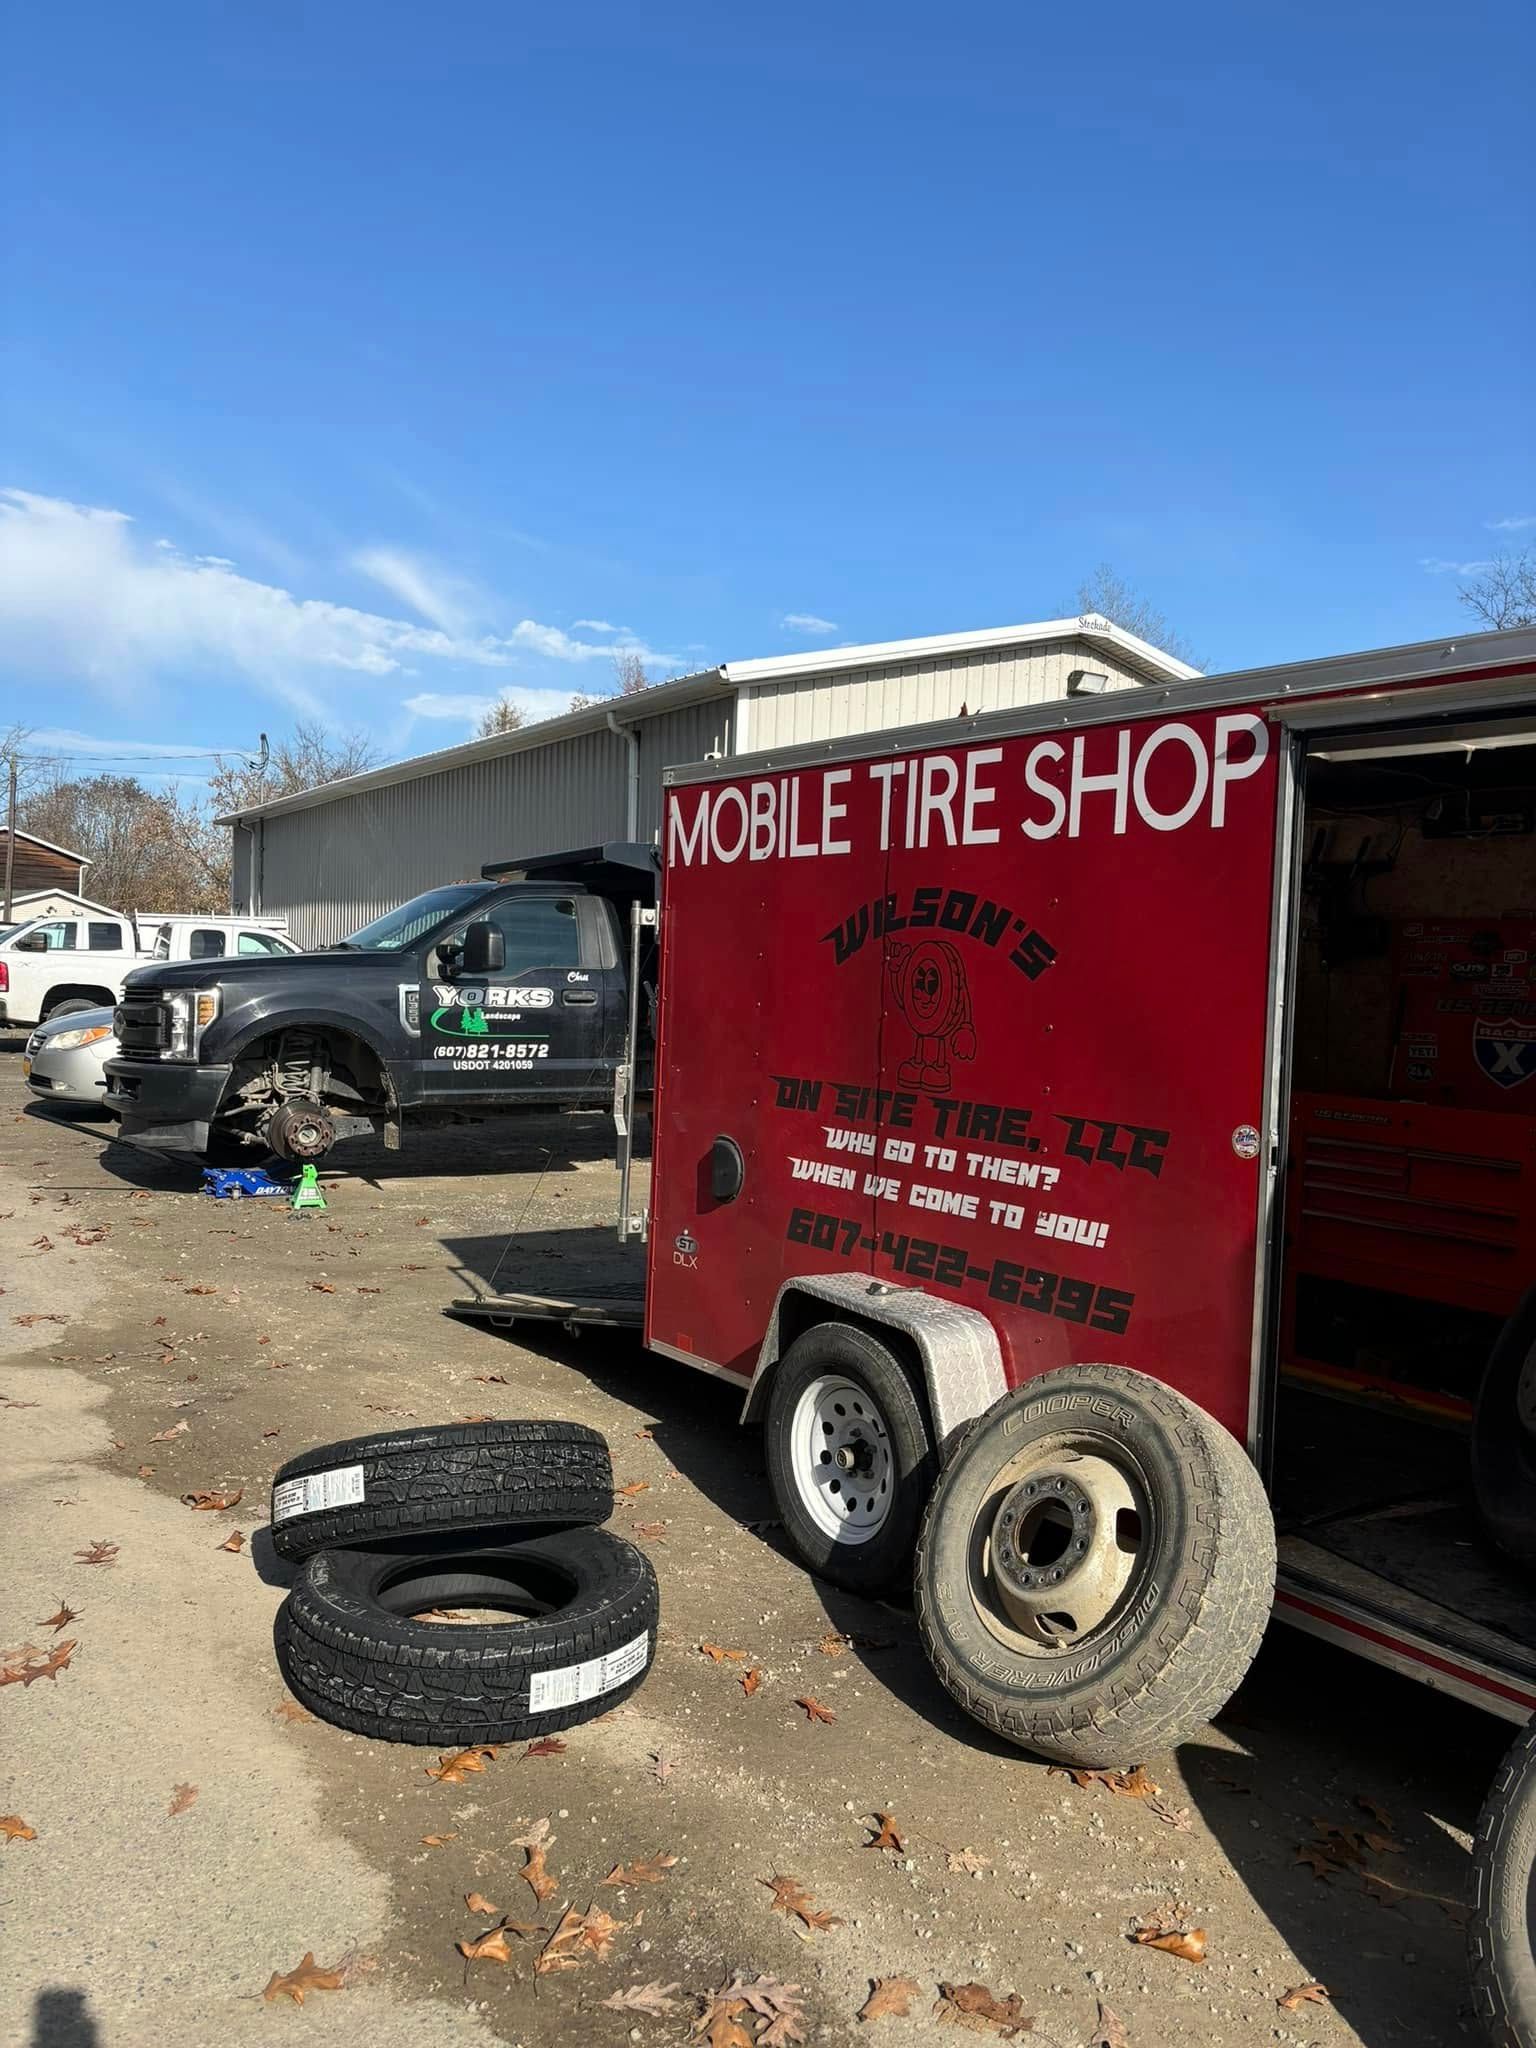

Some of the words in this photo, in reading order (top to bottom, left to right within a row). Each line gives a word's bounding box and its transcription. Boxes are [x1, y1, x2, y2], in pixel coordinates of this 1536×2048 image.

[669, 768, 852, 868] MOBILE
[869, 747, 1003, 851] TIRE
[1020, 713, 1270, 841] SHOP
[817, 887, 1058, 982] WILSON'S
[433, 985, 554, 1008] YORKS
[480, 1011, 521, 1022] Landscape
[433, 1044, 549, 1059] (607)821-8572
[453, 1061, 490, 1070] USDOT
[492, 1061, 533, 1070] 4201059
[1410, 1046, 1436, 1057] YETI
[1489, 1041, 1527, 1076] X
[768, 1075, 823, 1112] ON
[828, 1082, 918, 1128] SITE
[925, 1095, 1041, 1153] TIRE,
[1050, 1113, 1171, 1179] LLC
[821, 1126, 877, 1156] WHY
[883, 1138, 916, 1164] GO
[924, 1145, 958, 1172] TO
[966, 1152, 1061, 1191] THEM?
[787, 1156, 857, 1191] WHEN
[863, 1174, 901, 1202] WE
[908, 1183, 980, 1220] COME
[989, 1200, 1025, 1230] TO
[1034, 1211, 1110, 1248] YOU!
[673, 1251, 698, 1270] DLX
[679, 1237, 694, 1250] ST
[786, 1207, 1136, 1336] 607-422-6395
[1001, 1394, 1137, 1437] COOPER
[968, 1582, 1160, 1689] DISCOVERER
